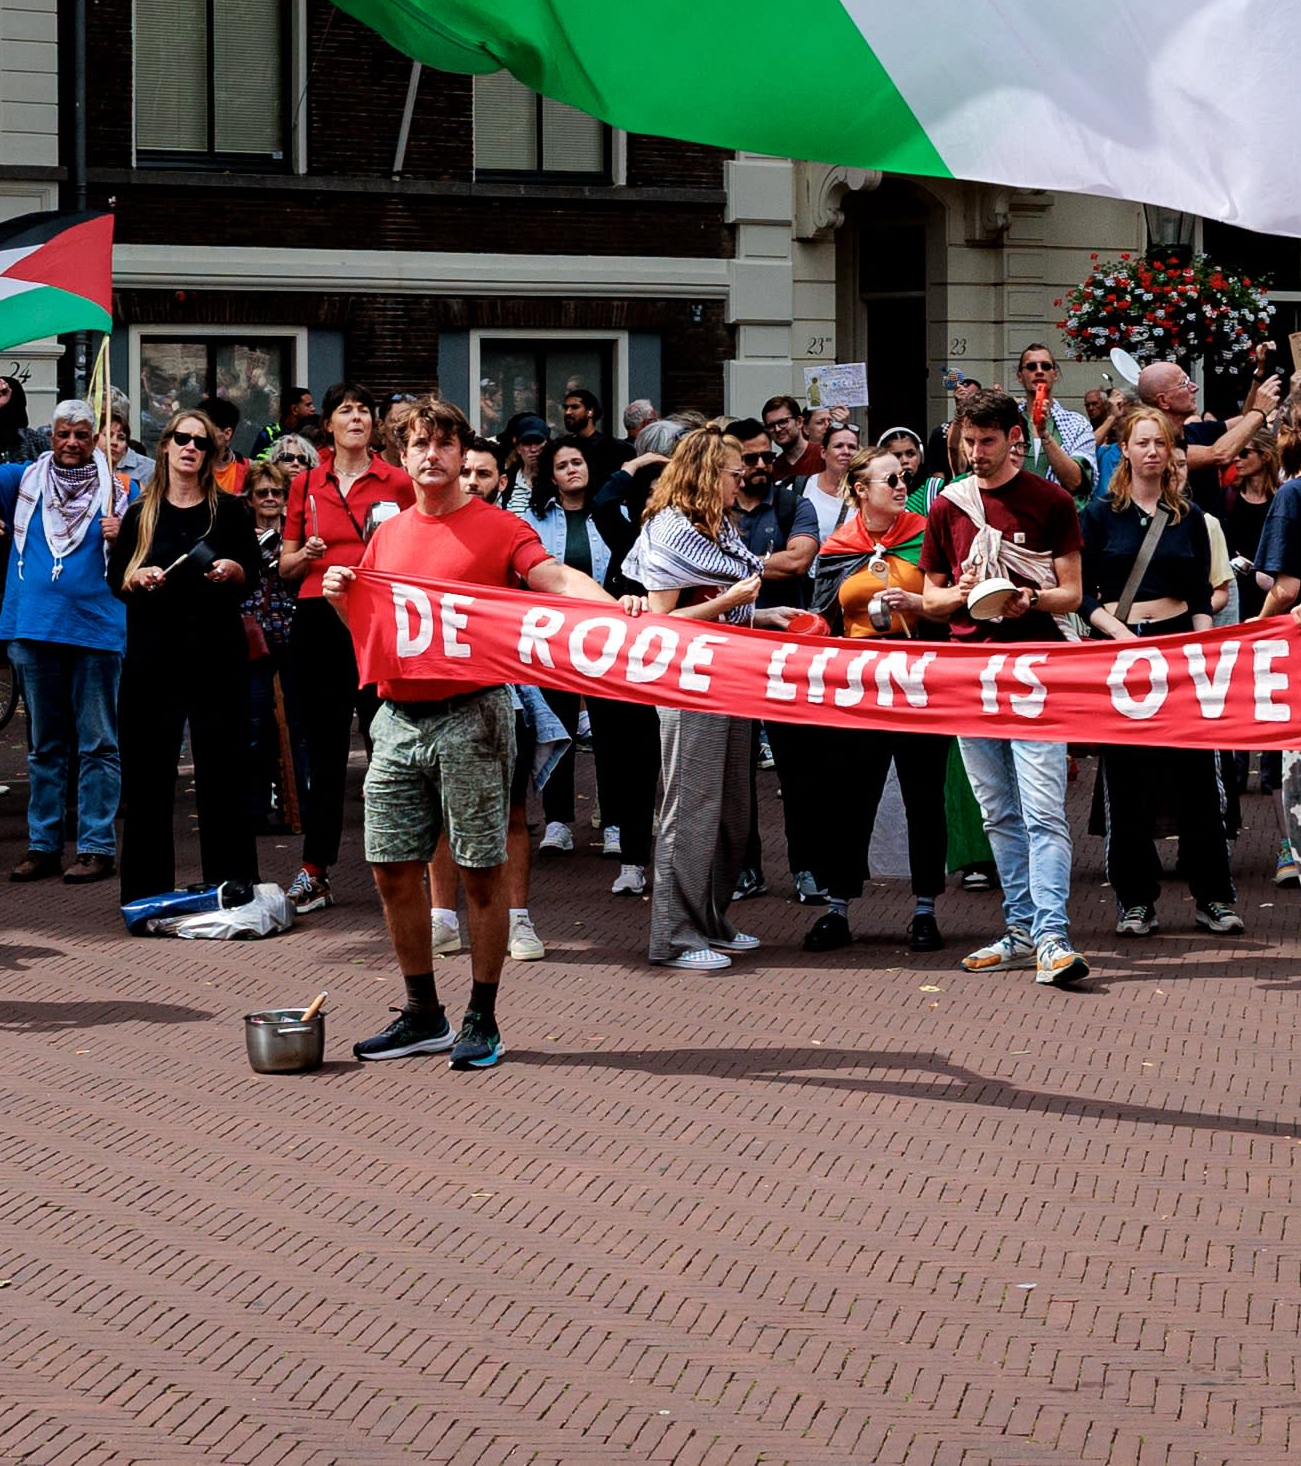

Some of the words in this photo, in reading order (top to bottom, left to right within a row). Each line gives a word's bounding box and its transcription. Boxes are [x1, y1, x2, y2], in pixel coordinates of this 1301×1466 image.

[950, 338, 967, 356] 23
[10, 361, 32, 384] 24
[391, 582, 477, 658] DE
[517, 606, 729, 692] RODE
[765, 642, 937, 708] LIJN
[979, 652, 1049, 719] IS
